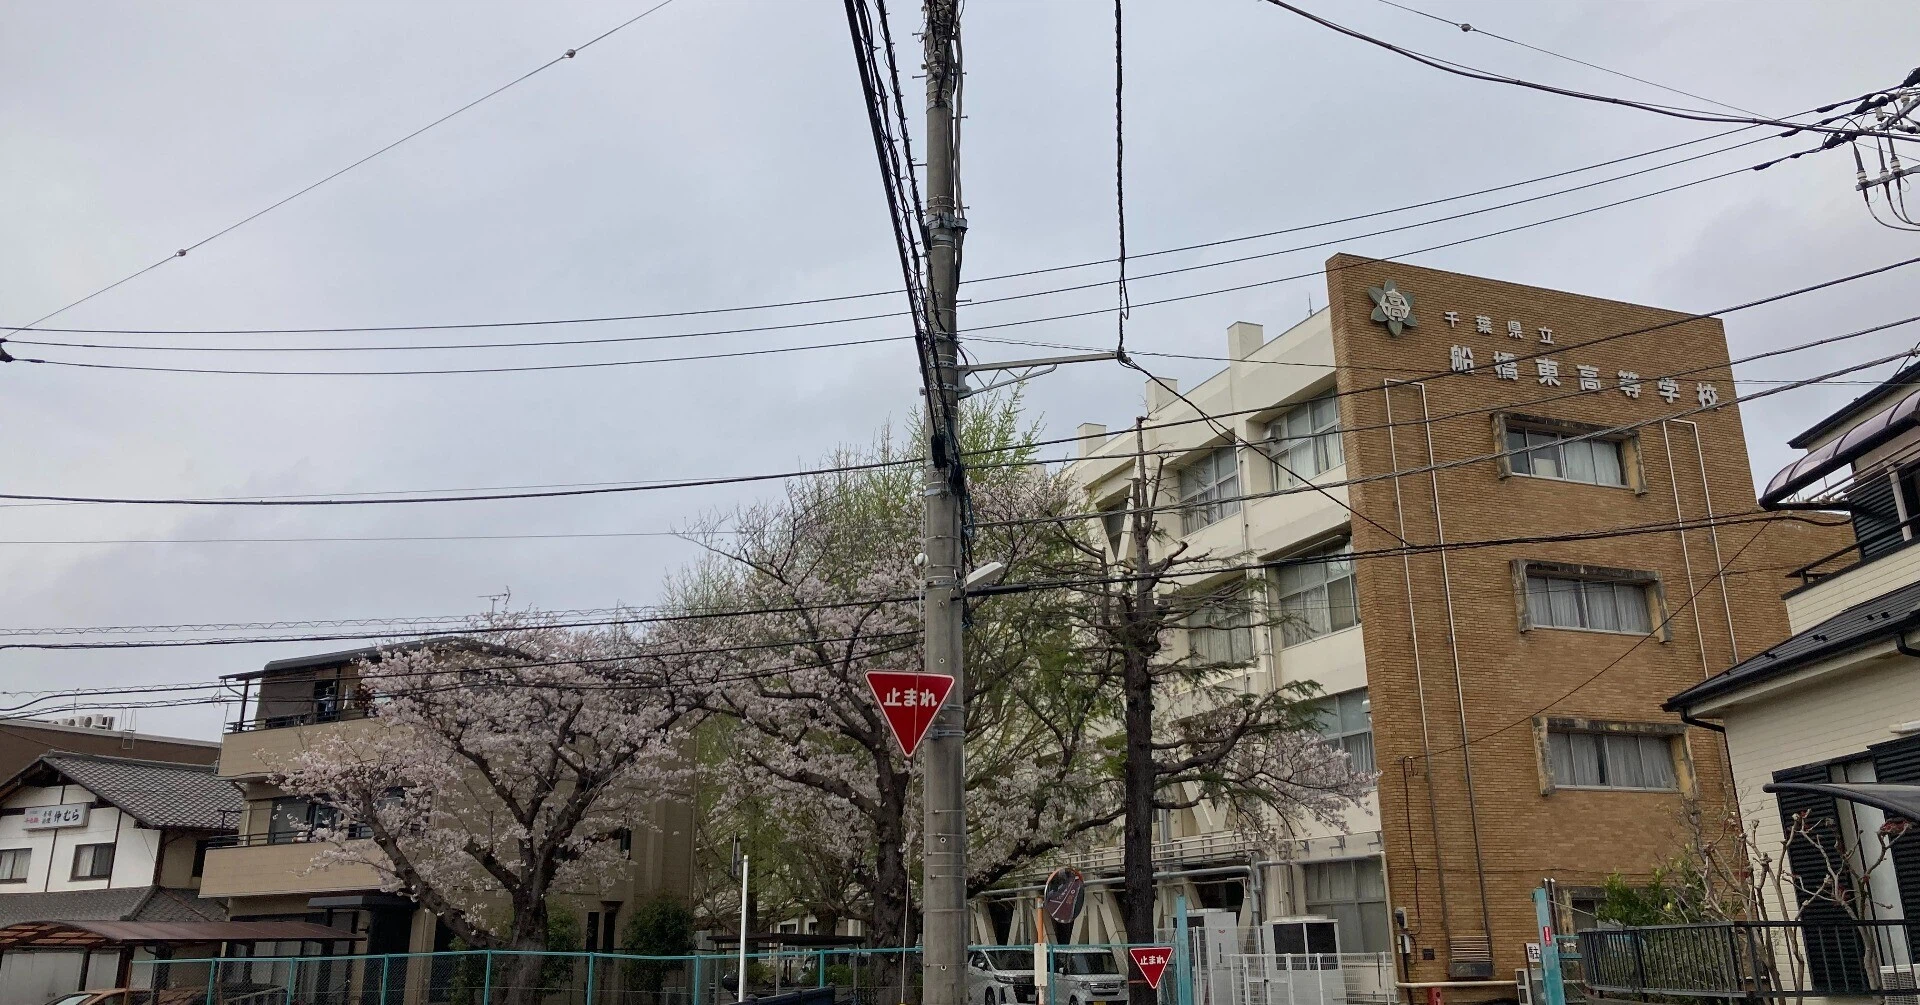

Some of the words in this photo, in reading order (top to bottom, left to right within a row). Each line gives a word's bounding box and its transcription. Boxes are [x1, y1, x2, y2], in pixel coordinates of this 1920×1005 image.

[1380, 289, 1410, 321] 高
[1444, 311, 1555, 344] 千葉県立
[1450, 344, 1720, 410] 船橋東高等学校
[883, 687, 937, 707] 止まれ
[1140, 955, 1165, 965] 止まれ
